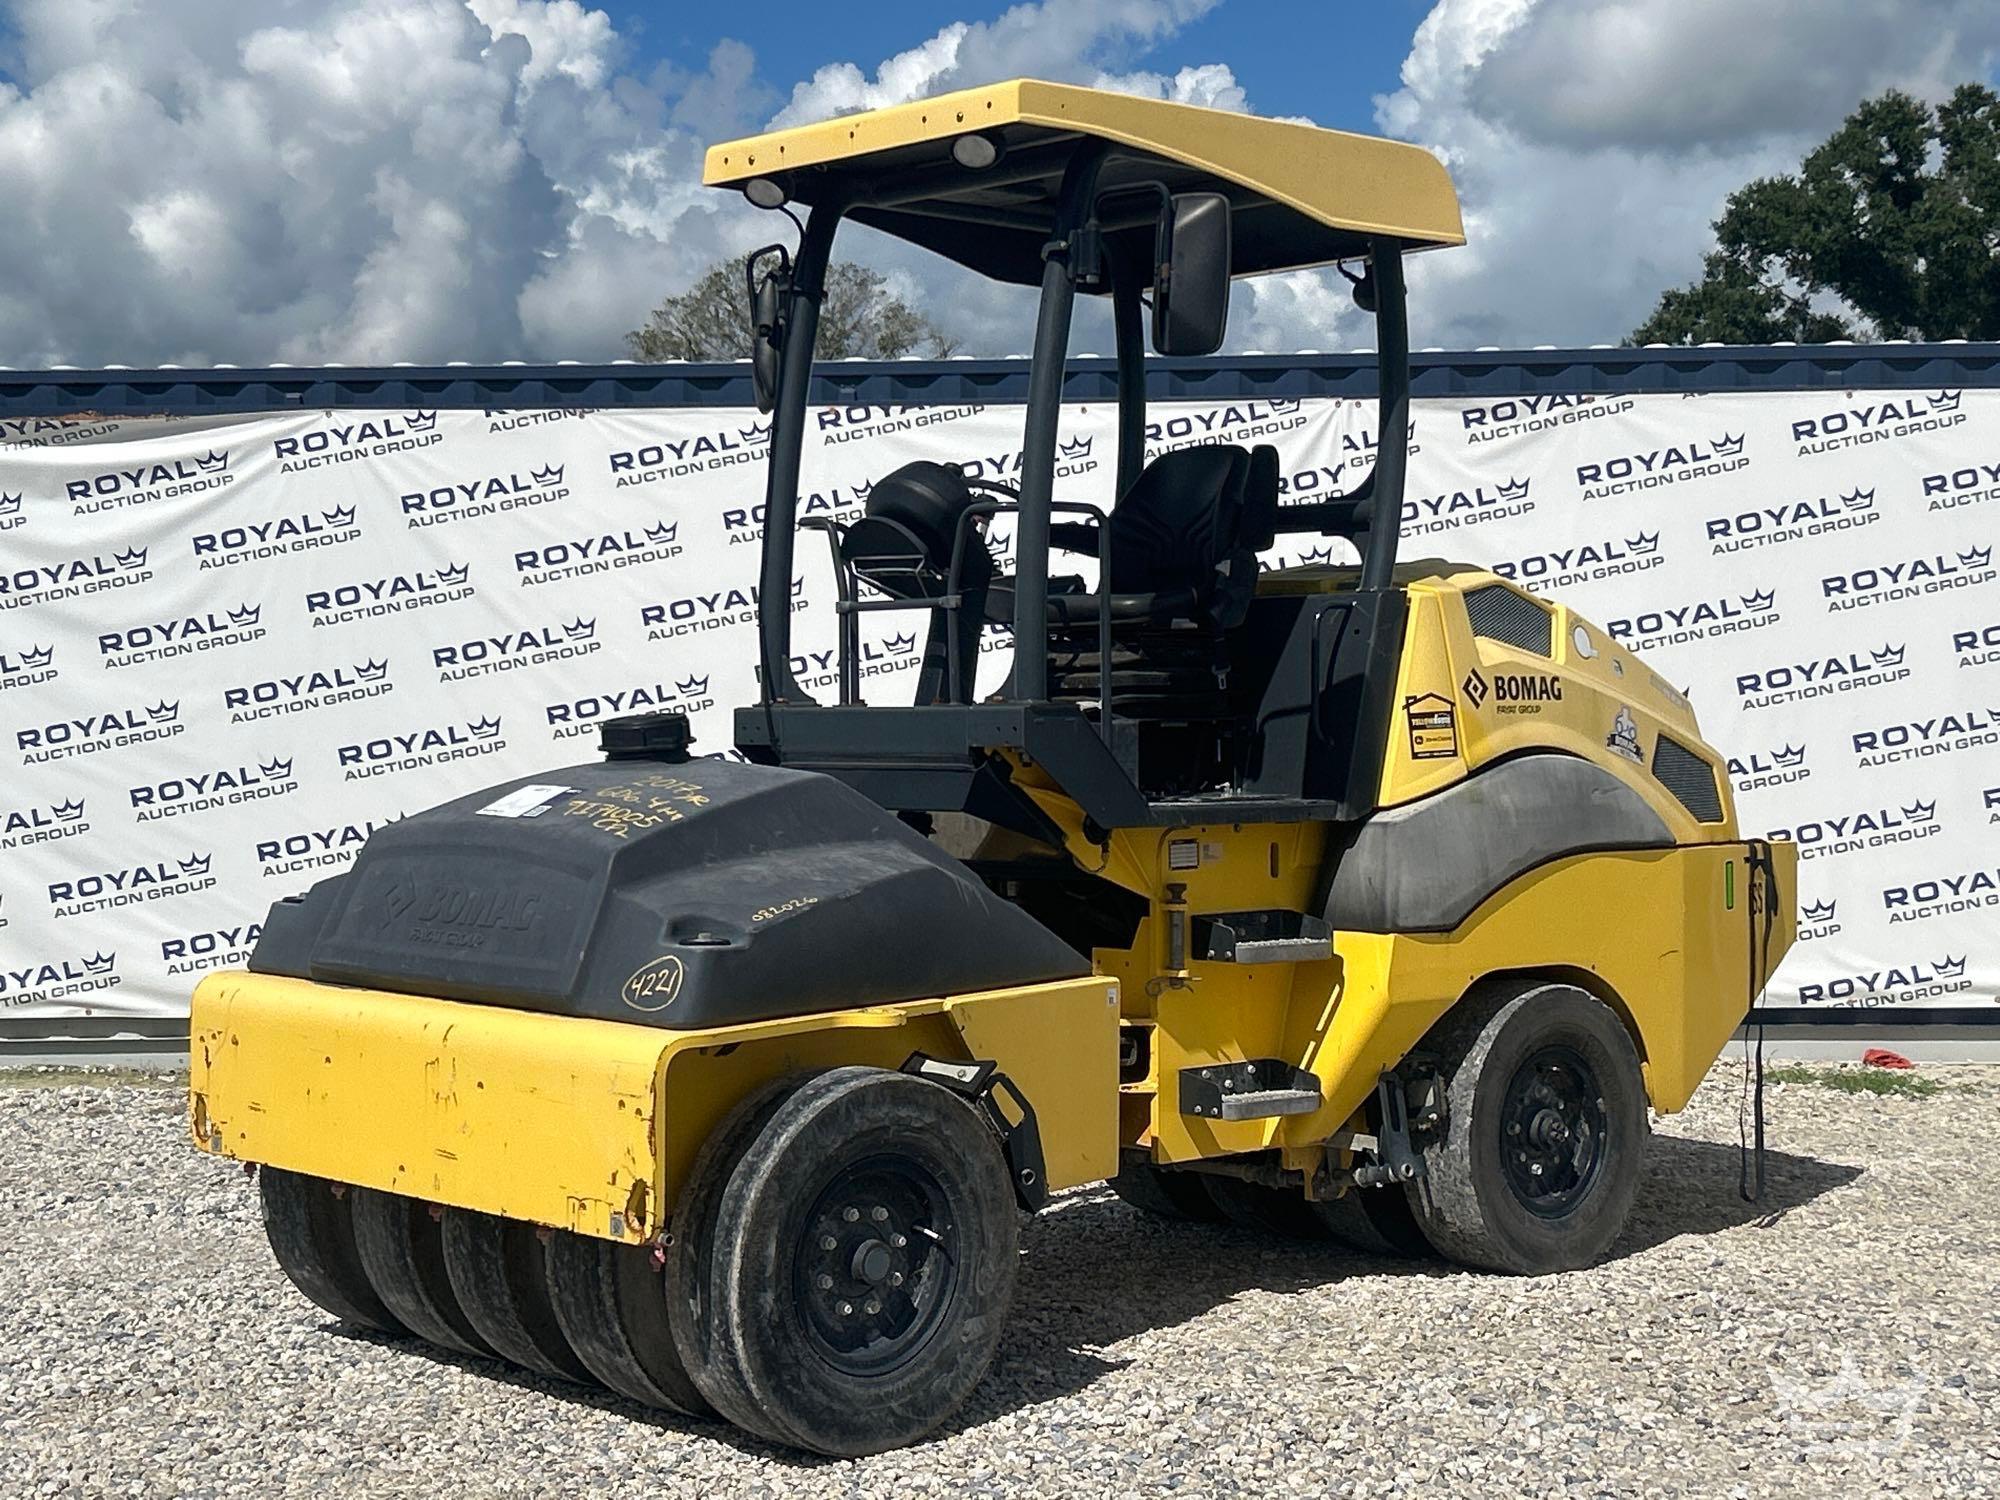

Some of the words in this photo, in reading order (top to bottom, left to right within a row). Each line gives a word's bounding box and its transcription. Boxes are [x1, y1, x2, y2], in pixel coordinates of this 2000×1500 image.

[51, 424, 120, 444] GROUP
[274, 419, 405, 458] ROYAL
[489, 407, 577, 433] AUCTION
[824, 419, 911, 446] AUCTION
[916, 405, 985, 427] GROUP
[1237, 416, 1307, 440] GROUP
[1468, 416, 1558, 444] AUCTION
[1562, 401, 1633, 424] GROUP
[1792, 400, 1927, 441] ROYAL
[1798, 429, 1889, 457] AUCTION
[1894, 414, 1966, 436] GROUP
[281, 448, 368, 473] AUCTION
[373, 434, 442, 455] GROUP
[610, 433, 740, 473] ROYAL
[617, 462, 703, 488] AUCTION
[708, 448, 770, 469] GROU
[1057, 461, 1098, 477] OUP
[1577, 444, 1711, 485] ROYAL
[66, 461, 197, 501] ROYAL
[74, 490, 161, 516] AUCTION
[165, 475, 233, 497] GROUP
[401, 475, 531, 514] ROYAL
[1583, 474, 1673, 501] AUCTION
[1678, 458, 1749, 480] GROUP
[1922, 464, 2000, 496] ROY
[1929, 488, 2000, 511] AUCTIO
[408, 503, 495, 529] AUCTION
[500, 489, 569, 510] GROUP
[1399, 517, 1460, 538] CTION
[1464, 502, 1535, 524] GROUP
[1401, 488, 1497, 522] OYAL
[1706, 498, 1841, 540] ROYAL
[192, 515, 323, 555] ROYAL
[200, 544, 287, 570] AUCTION
[292, 530, 361, 551] GROUP
[515, 532, 644, 571] ROYAL
[1713, 528, 1803, 555] AUCTION
[1808, 513, 1880, 535] GROUP
[84, 571, 153, 593] GROUP
[521, 561, 609, 586] AUCTION
[614, 546, 682, 568] GROUP
[1521, 572, 1588, 592] CTION
[1593, 557, 1664, 579] GROUP
[1822, 556, 1958, 597] ROYAL
[306, 573, 437, 613] ROYAL
[313, 602, 401, 627] AUCTION
[405, 587, 474, 609] GROUP
[1829, 586, 1920, 612] AUCTION
[1925, 570, 1996, 593] GROUP
[99, 614, 228, 654] ROYAL
[648, 615, 735, 641] AUCTION
[1607, 599, 1741, 640] ROYAL
[1627, 629, 1703, 653] UCTION
[1709, 614, 1780, 636] GROUP
[105, 643, 192, 669] AUCTION
[197, 629, 266, 650] GROUP
[433, 628, 563, 667] ROYAL
[440, 657, 527, 683] AUCTION
[532, 642, 601, 664] GROUP
[0, 670, 58, 690] ROUP
[225, 669, 355, 709] ROYAL
[1494, 675, 1562, 701] BOMAG
[1737, 654, 1871, 695] ROYAL
[1743, 684, 1833, 710] AUCTION
[1838, 669, 1910, 691] GROUP
[232, 698, 319, 724] AUCTION
[324, 684, 392, 705] GROUP
[546, 685, 676, 725] ROYAL
[17, 710, 147, 750] ROYAL
[23, 739, 111, 765] AUCTION
[115, 725, 184, 746] GROUP
[338, 726, 469, 766] ROYAL
[1853, 713, 1988, 753] ROYAL
[345, 755, 432, 781] AUCTION
[437, 741, 506, 762] GROUP
[1859, 742, 1950, 768] AUCTION
[1956, 733, 1999, 749] GRO
[130, 768, 260, 807] ROYAL
[1739, 769, 1810, 791] GROUP
[137, 796, 224, 822] AUCTION
[229, 782, 298, 804] GROUP
[21, 823, 89, 845] GROUP
[1801, 839, 1864, 860] CTION
[1869, 825, 1941, 847] GROUP
[48, 863, 179, 903] ROYAL
[263, 851, 351, 877] AUCTION
[55, 892, 143, 918] AUCTION
[147, 878, 216, 900] GROUP
[1883, 869, 2000, 908] ROYA
[1889, 898, 1980, 924] AUCTION
[162, 924, 261, 960] ROYA
[1799, 924, 1841, 941] OUP
[0, 962, 83, 993] YAL
[0, 990, 47, 1007] TION
[52, 976, 121, 997] GROUP
[1799, 966, 1933, 1004] ROYAL
[1900, 980, 1972, 1001] GROUP
